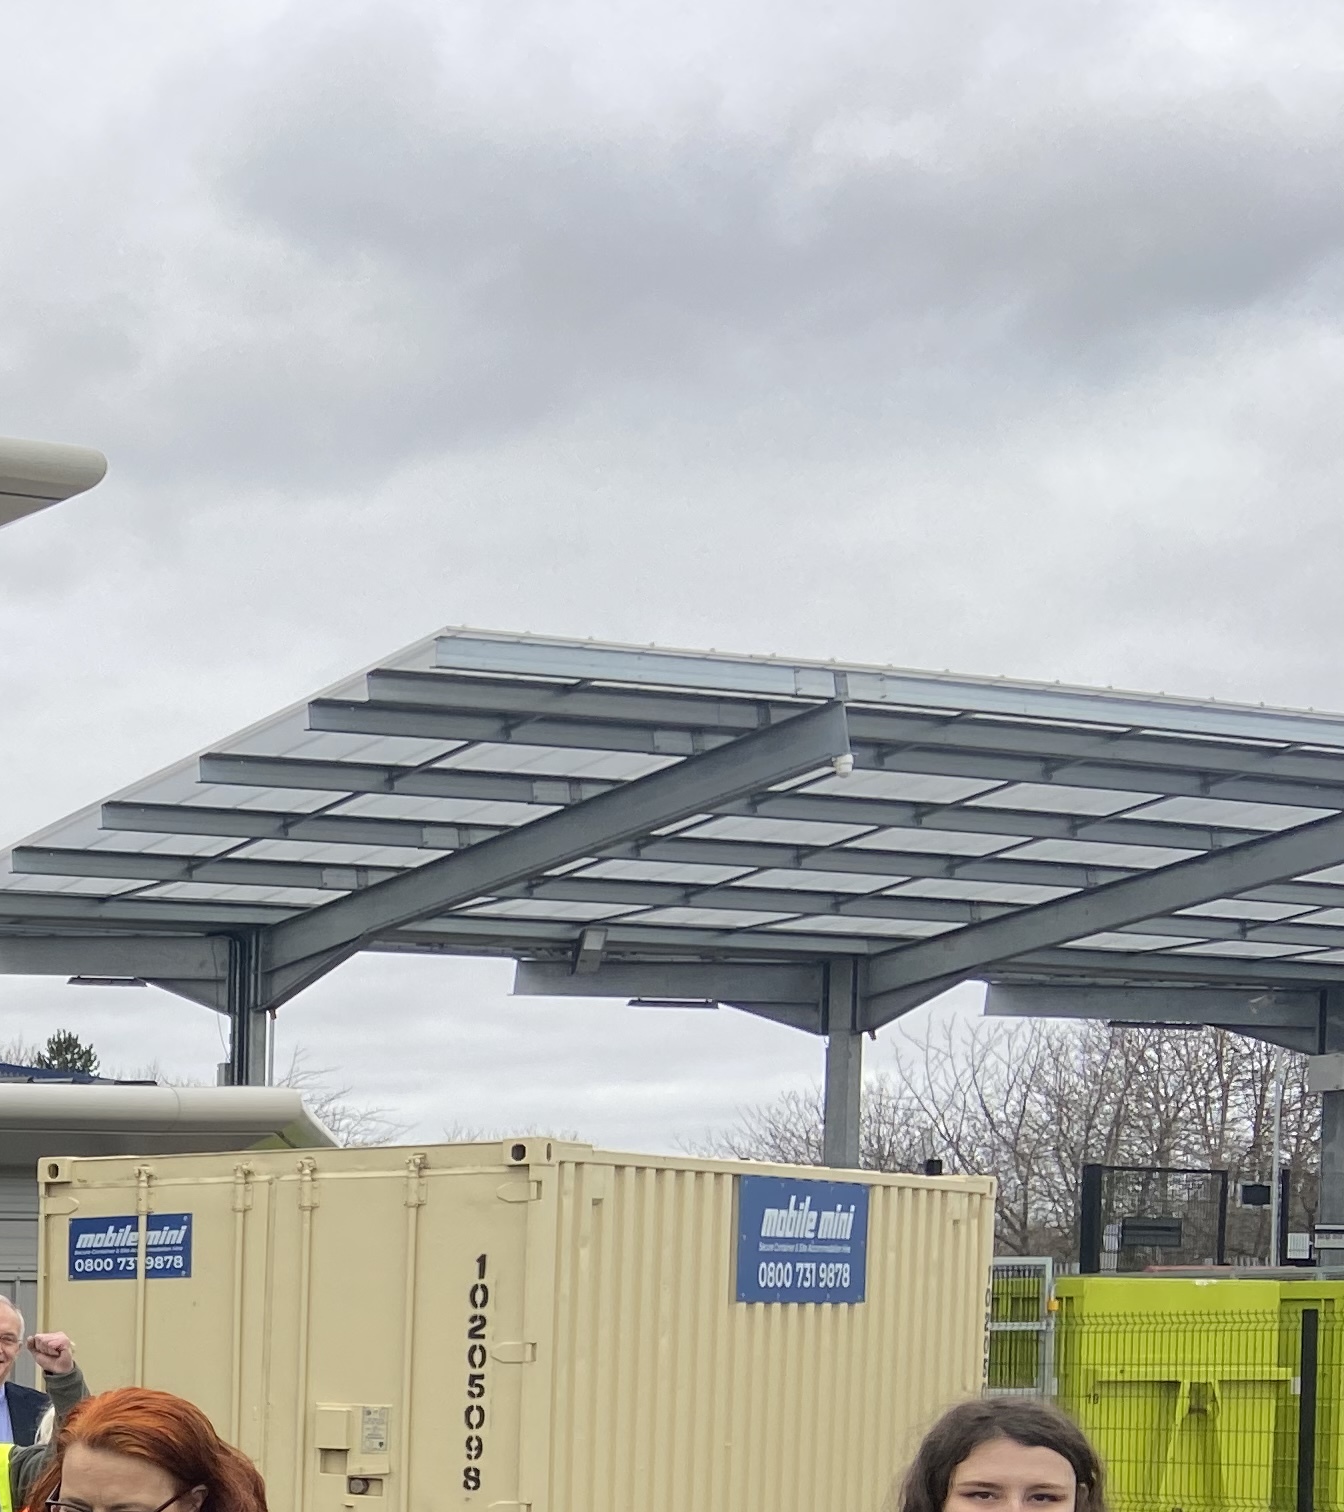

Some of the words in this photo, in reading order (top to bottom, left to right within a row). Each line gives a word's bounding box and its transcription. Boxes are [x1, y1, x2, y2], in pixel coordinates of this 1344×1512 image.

[761, 1195, 818, 1238] mobile
[817, 1204, 855, 1239] mini
[76, 1225, 139, 1248] mobile
[74, 1258, 114, 1272] 0800
[145, 1255, 183, 1269] 9878
[758, 1262, 793, 1288] 0800
[795, 1262, 817, 1288] 731
[818, 1262, 851, 1288] 9878
[463, 1254, 489, 1491] 10205098
